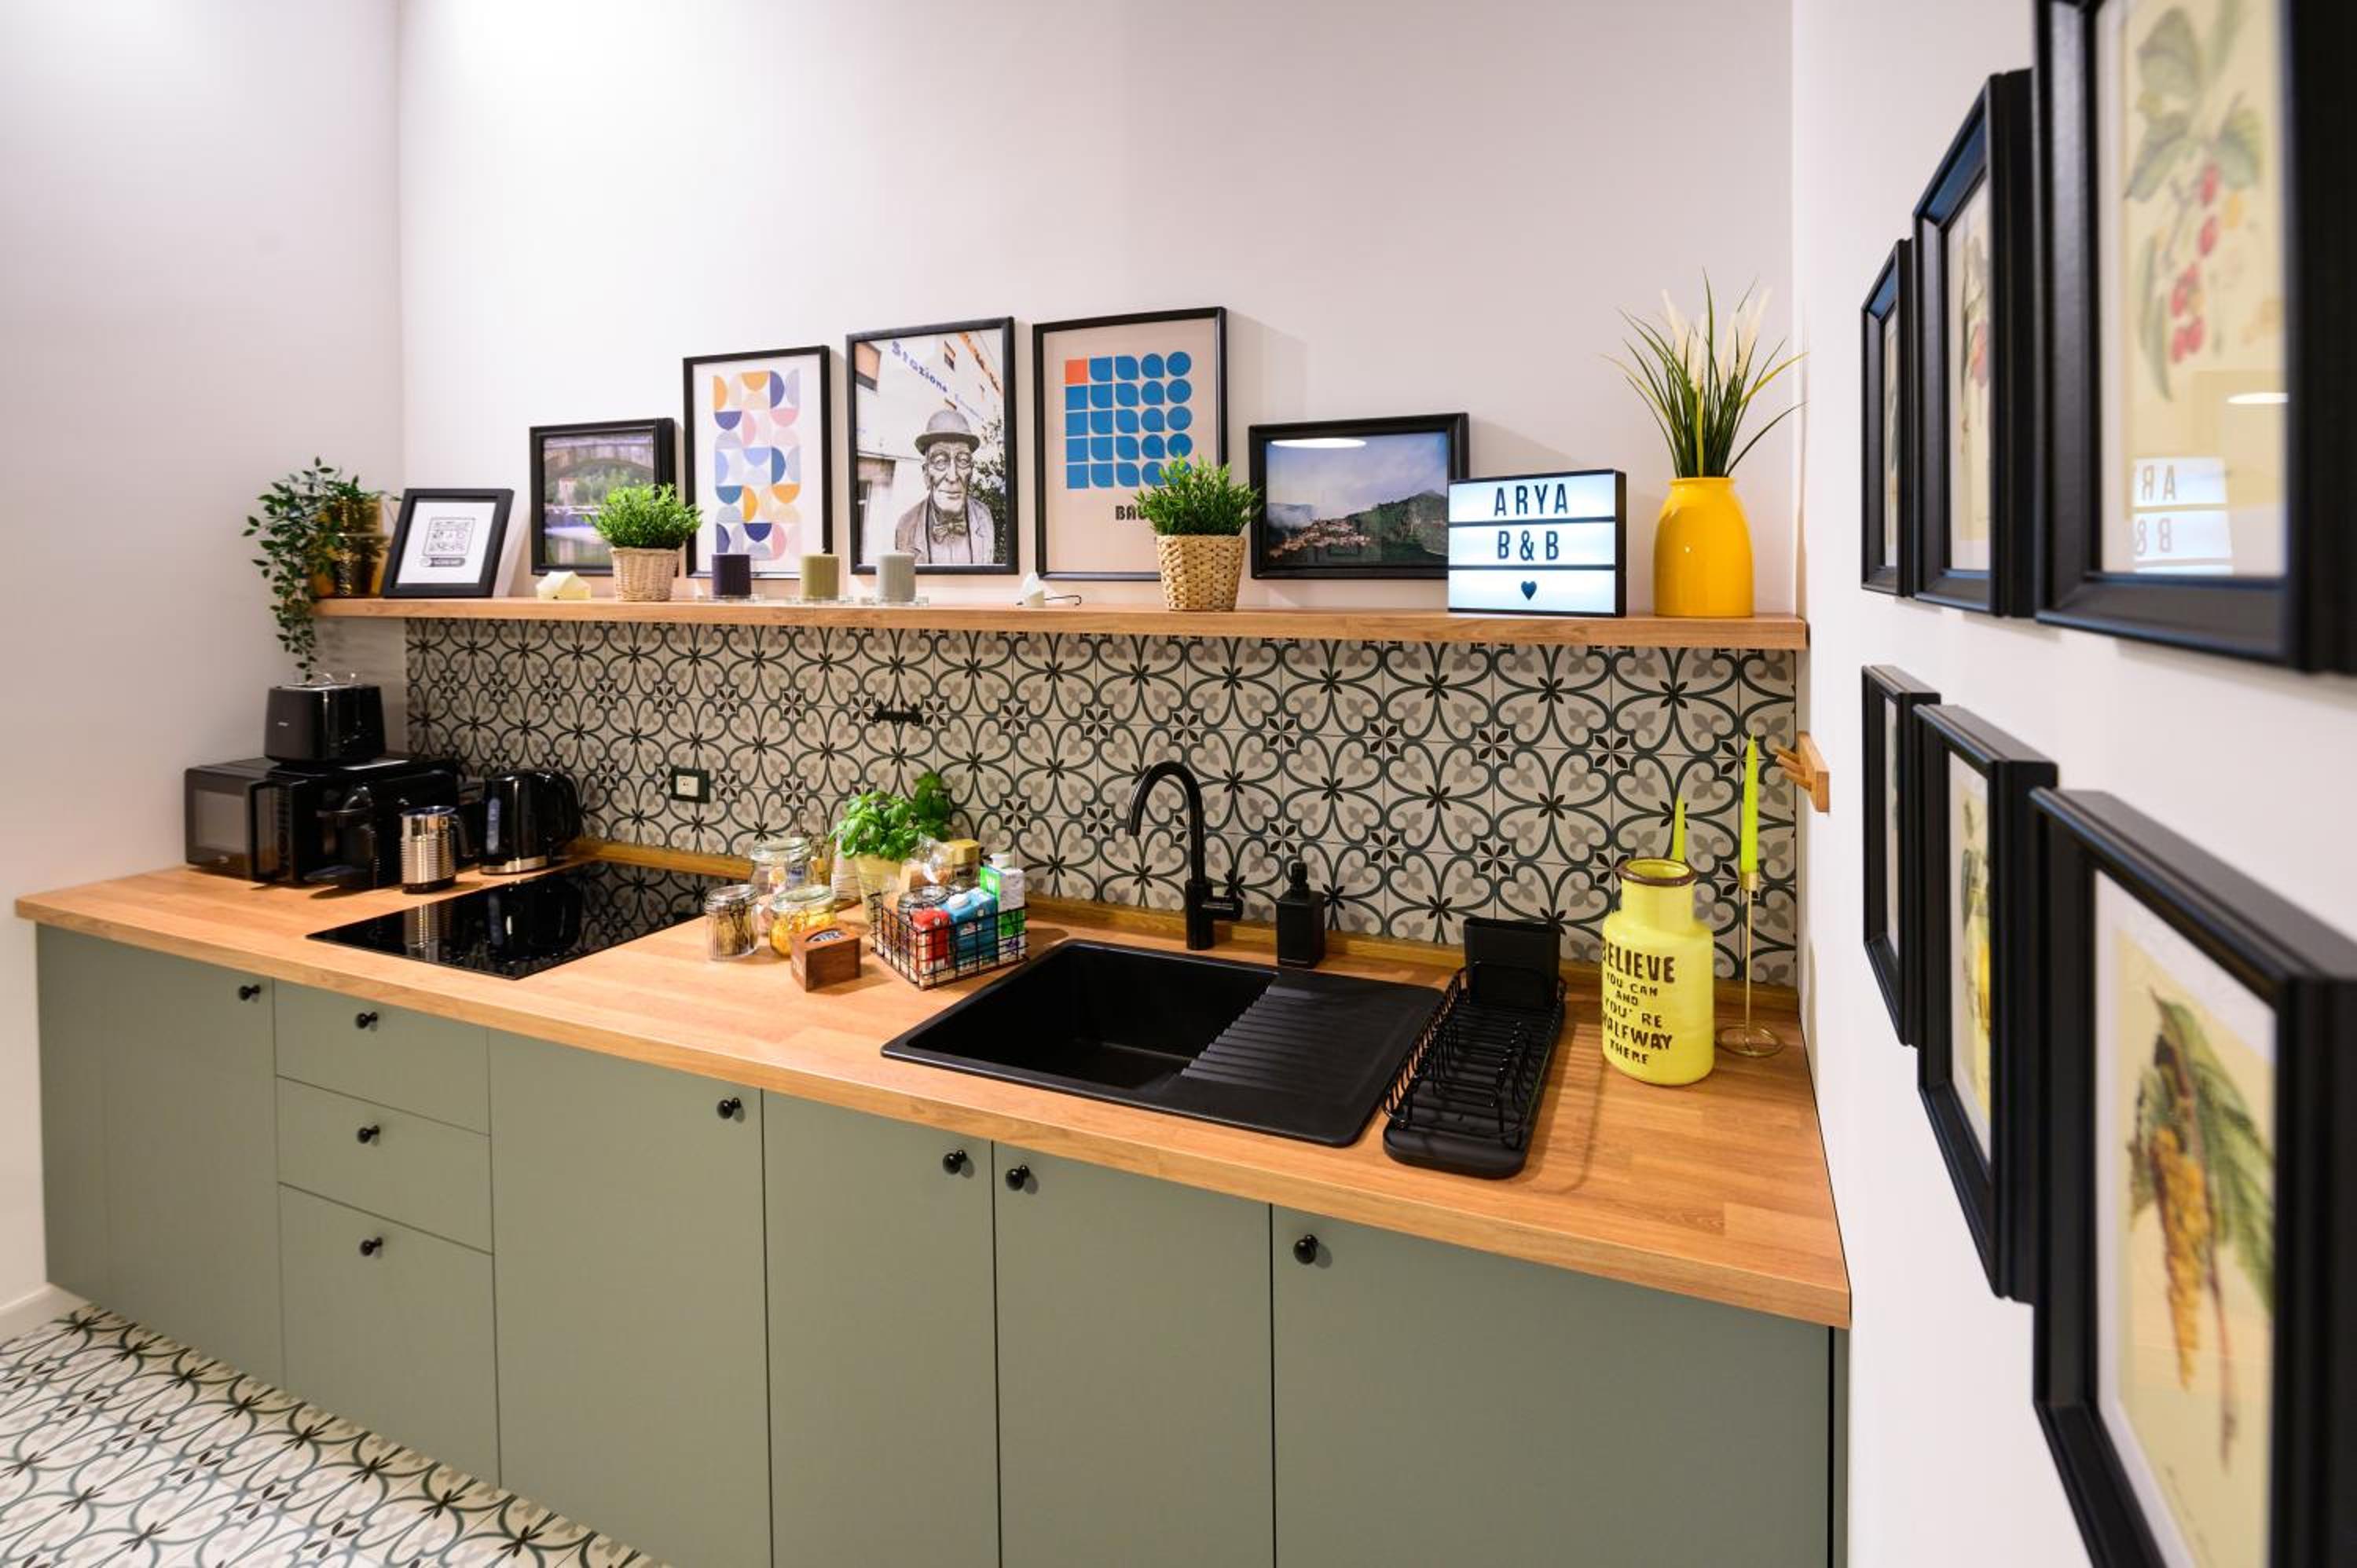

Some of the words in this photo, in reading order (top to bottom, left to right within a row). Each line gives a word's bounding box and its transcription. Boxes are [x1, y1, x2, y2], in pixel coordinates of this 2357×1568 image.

[1494, 483, 1568, 516] ARYA
[1497, 529, 1560, 561] B&B
[1607, 973, 1622, 989] YOU
[1629, 983, 1659, 997] CAN
[1616, 991, 1638, 1006] AND
[1610, 1039, 1649, 1065] THERE
